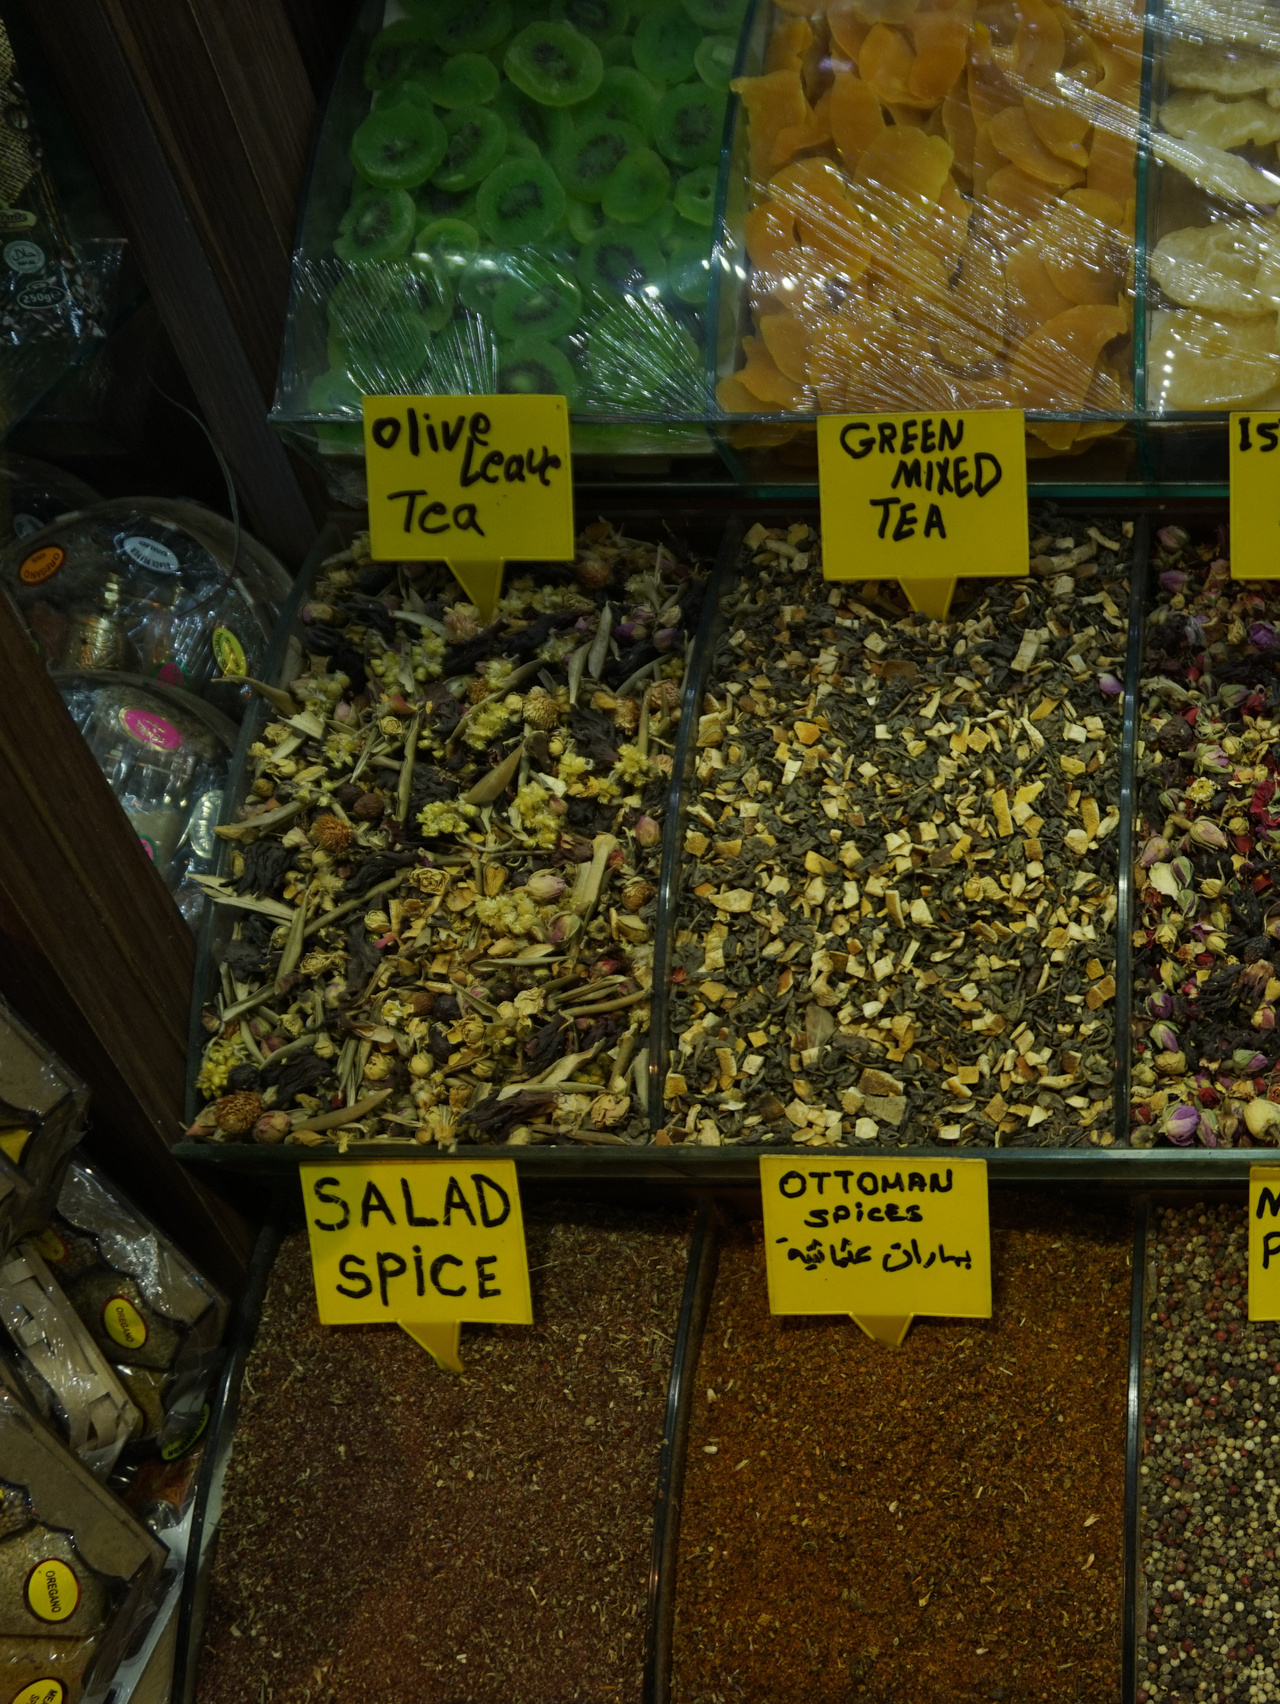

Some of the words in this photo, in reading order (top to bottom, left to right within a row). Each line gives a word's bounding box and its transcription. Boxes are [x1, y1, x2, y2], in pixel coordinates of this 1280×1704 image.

[839, 418, 965, 460] GREEN
[890, 452, 1003, 498] MIXED
[386, 488, 486, 537] Tea
[869, 497, 947, 542] TEA
[313, 1173, 511, 1232] SALAD
[779, 1169, 953, 1199] OTTOMAN
[115, 1306, 135, 1344] OREGANO
[45, 1570, 61, 1614] OREGANO
